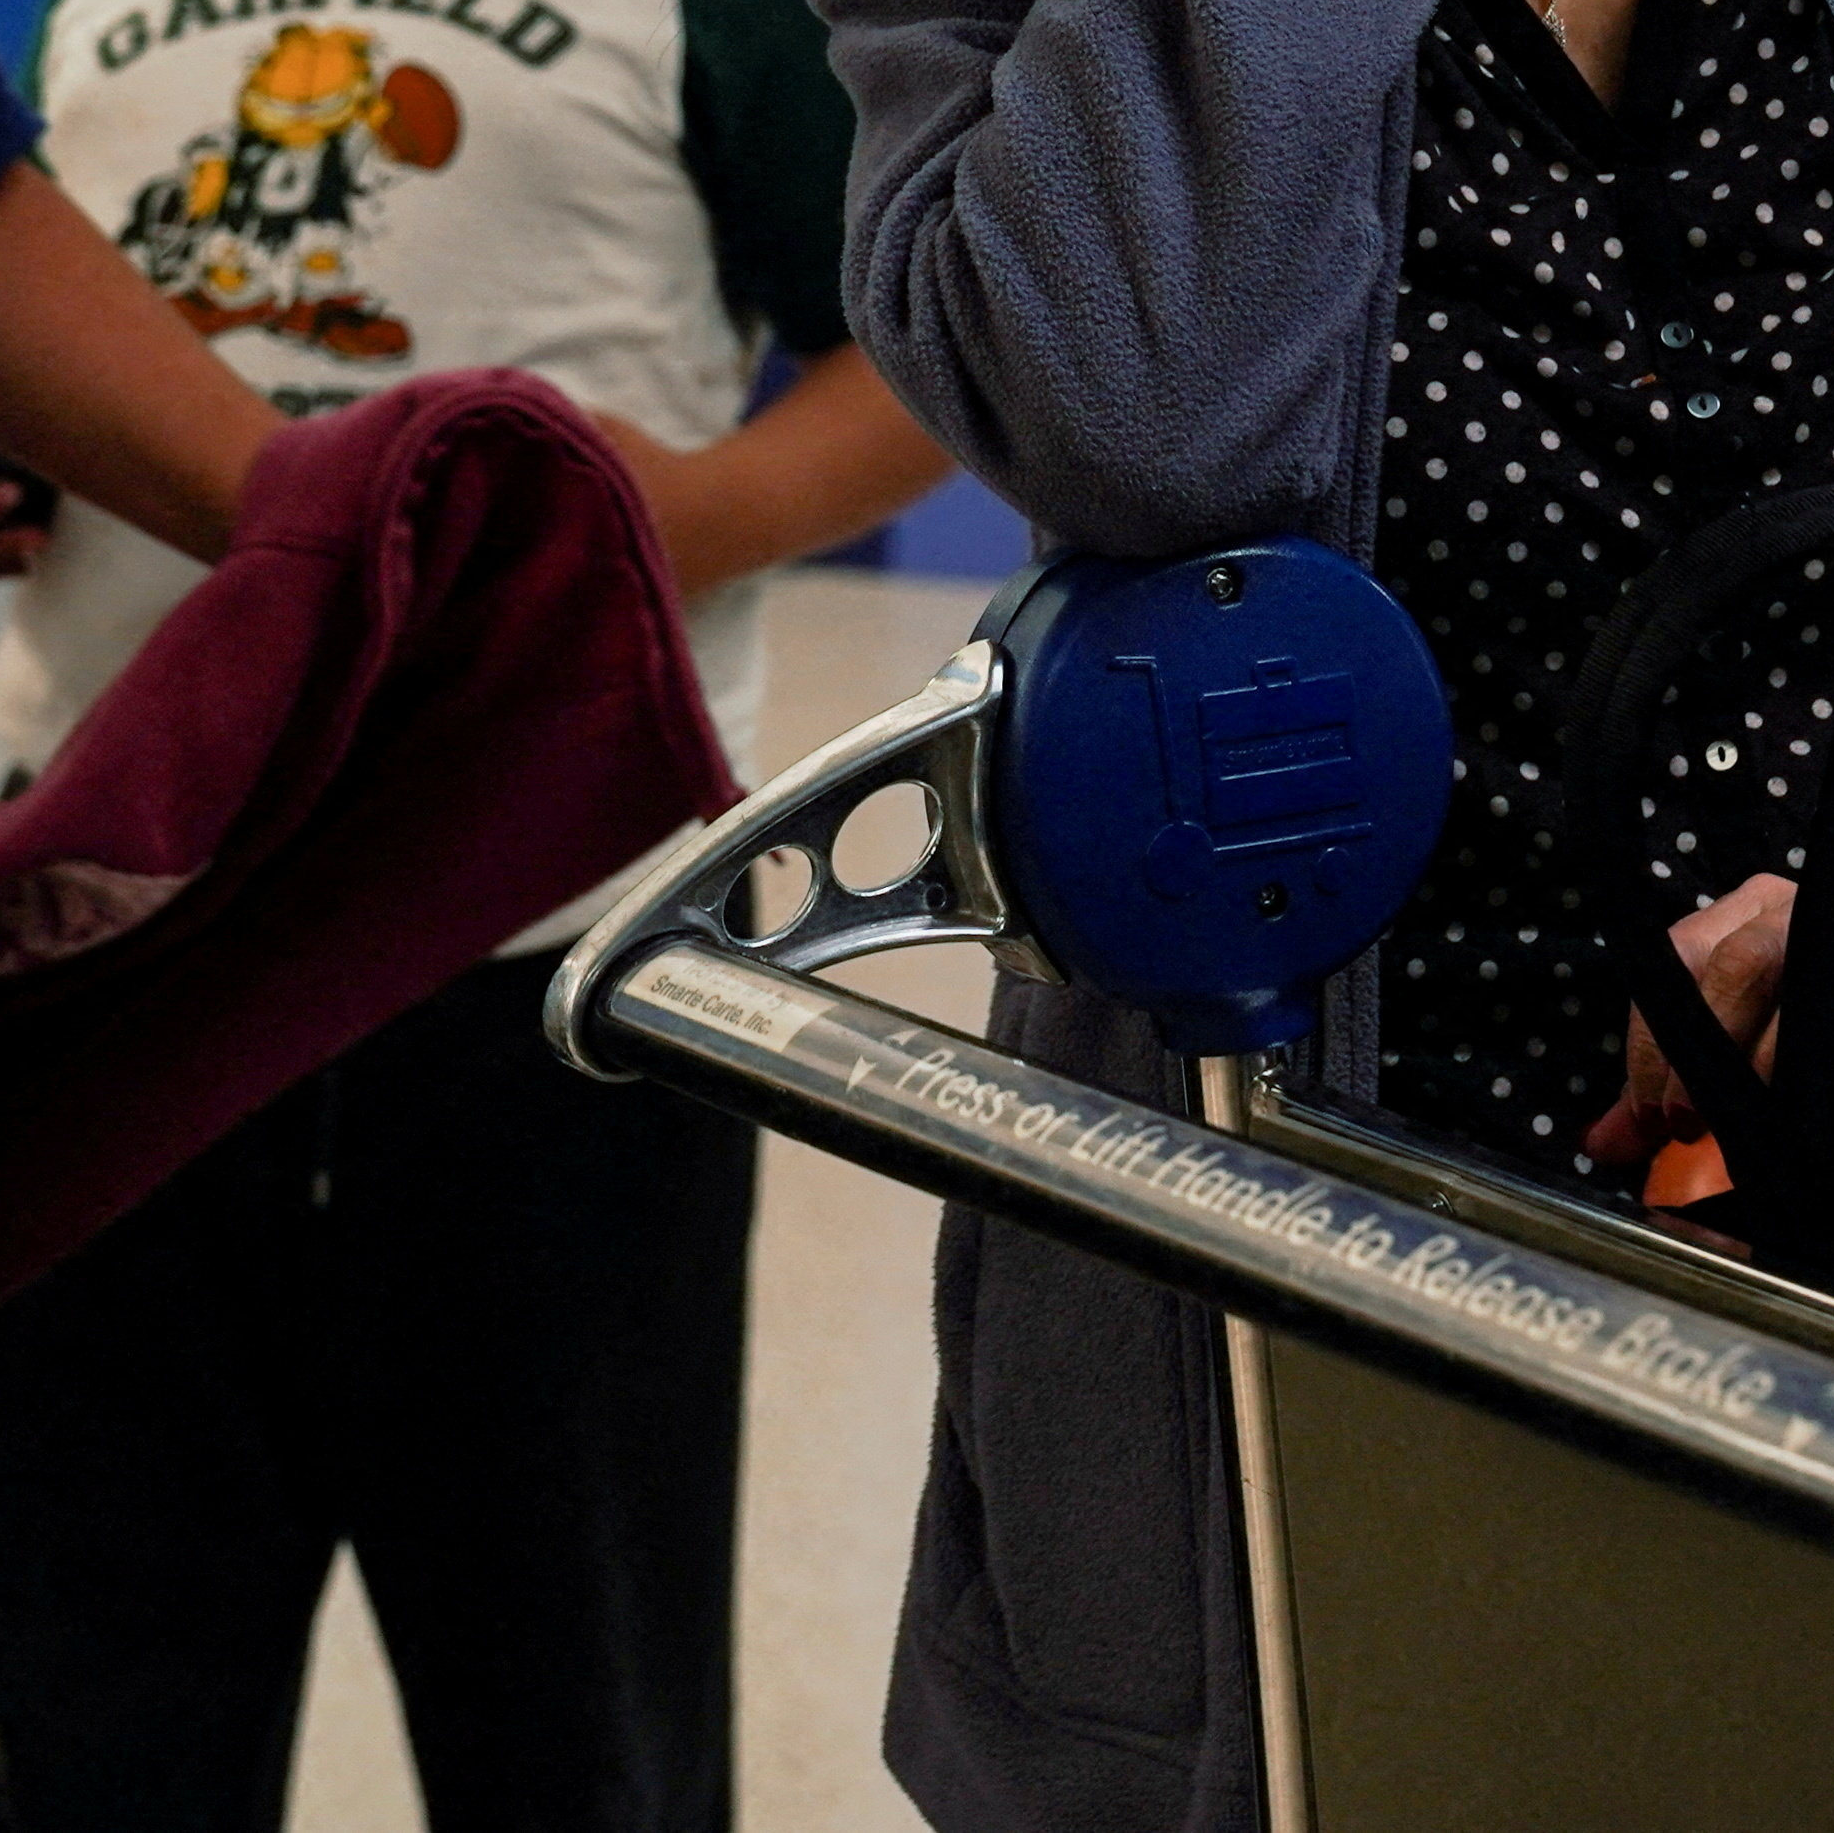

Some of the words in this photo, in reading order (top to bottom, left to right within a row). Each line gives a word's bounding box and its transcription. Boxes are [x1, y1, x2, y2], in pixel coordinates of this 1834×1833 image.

[650, 975, 704, 1008] Smarte
[702, 994, 745, 1025] Carte,
[744, 1010, 773, 1035] Inc.
[894, 1047, 1019, 1125] Press
[1014, 1101, 1080, 1145] or
[1068, 1111, 1167, 1177] Lift
[1147, 1142, 1335, 1245] Handle
[1329, 1211, 1396, 1267] to
[1391, 1234, 1604, 1353] Release
[1599, 1312, 1777, 1418] Brake
